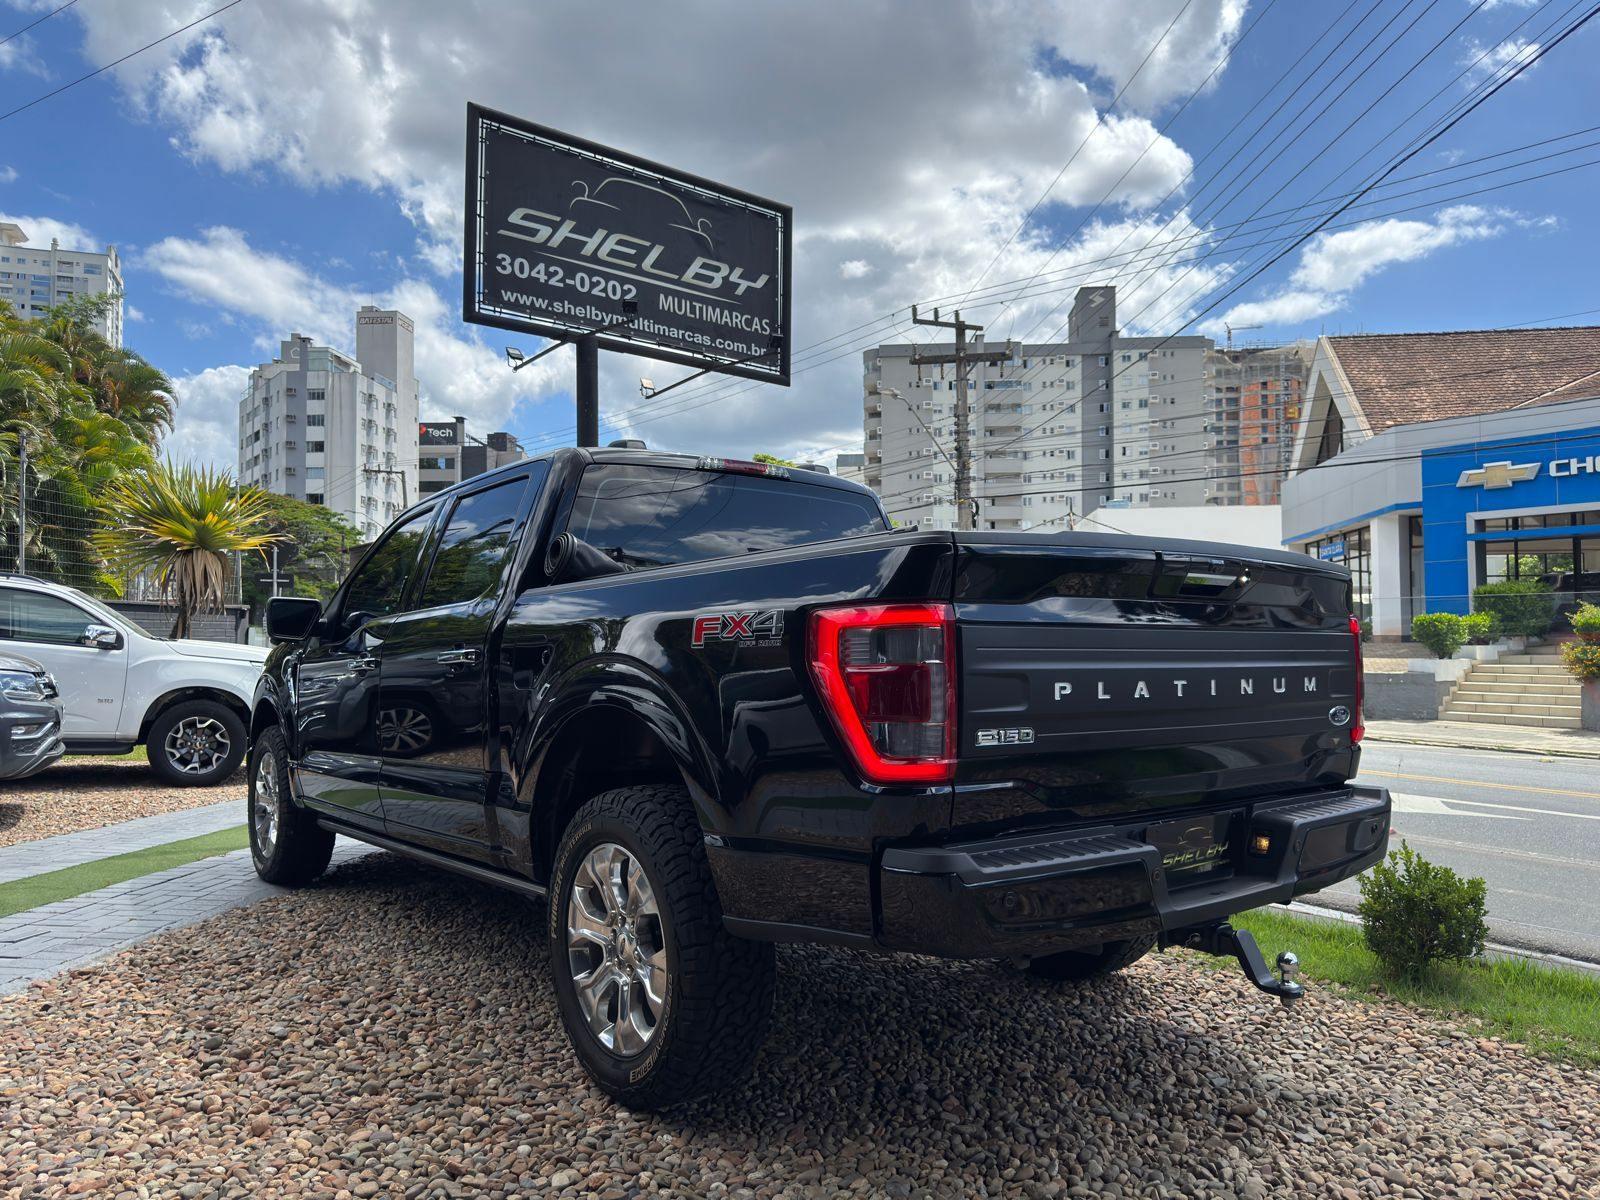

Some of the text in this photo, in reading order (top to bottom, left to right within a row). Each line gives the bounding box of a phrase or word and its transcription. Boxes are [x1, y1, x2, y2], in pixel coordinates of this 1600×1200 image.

[497, 207, 771, 296] SHELBY
[495, 252, 637, 301] 3042-0202
[659, 293, 771, 336] MULTIMARCAS
[427, 428, 453, 437] Tech
[691, 608, 785, 649] FX4
[1054, 676, 1317, 701] PLATINUM
